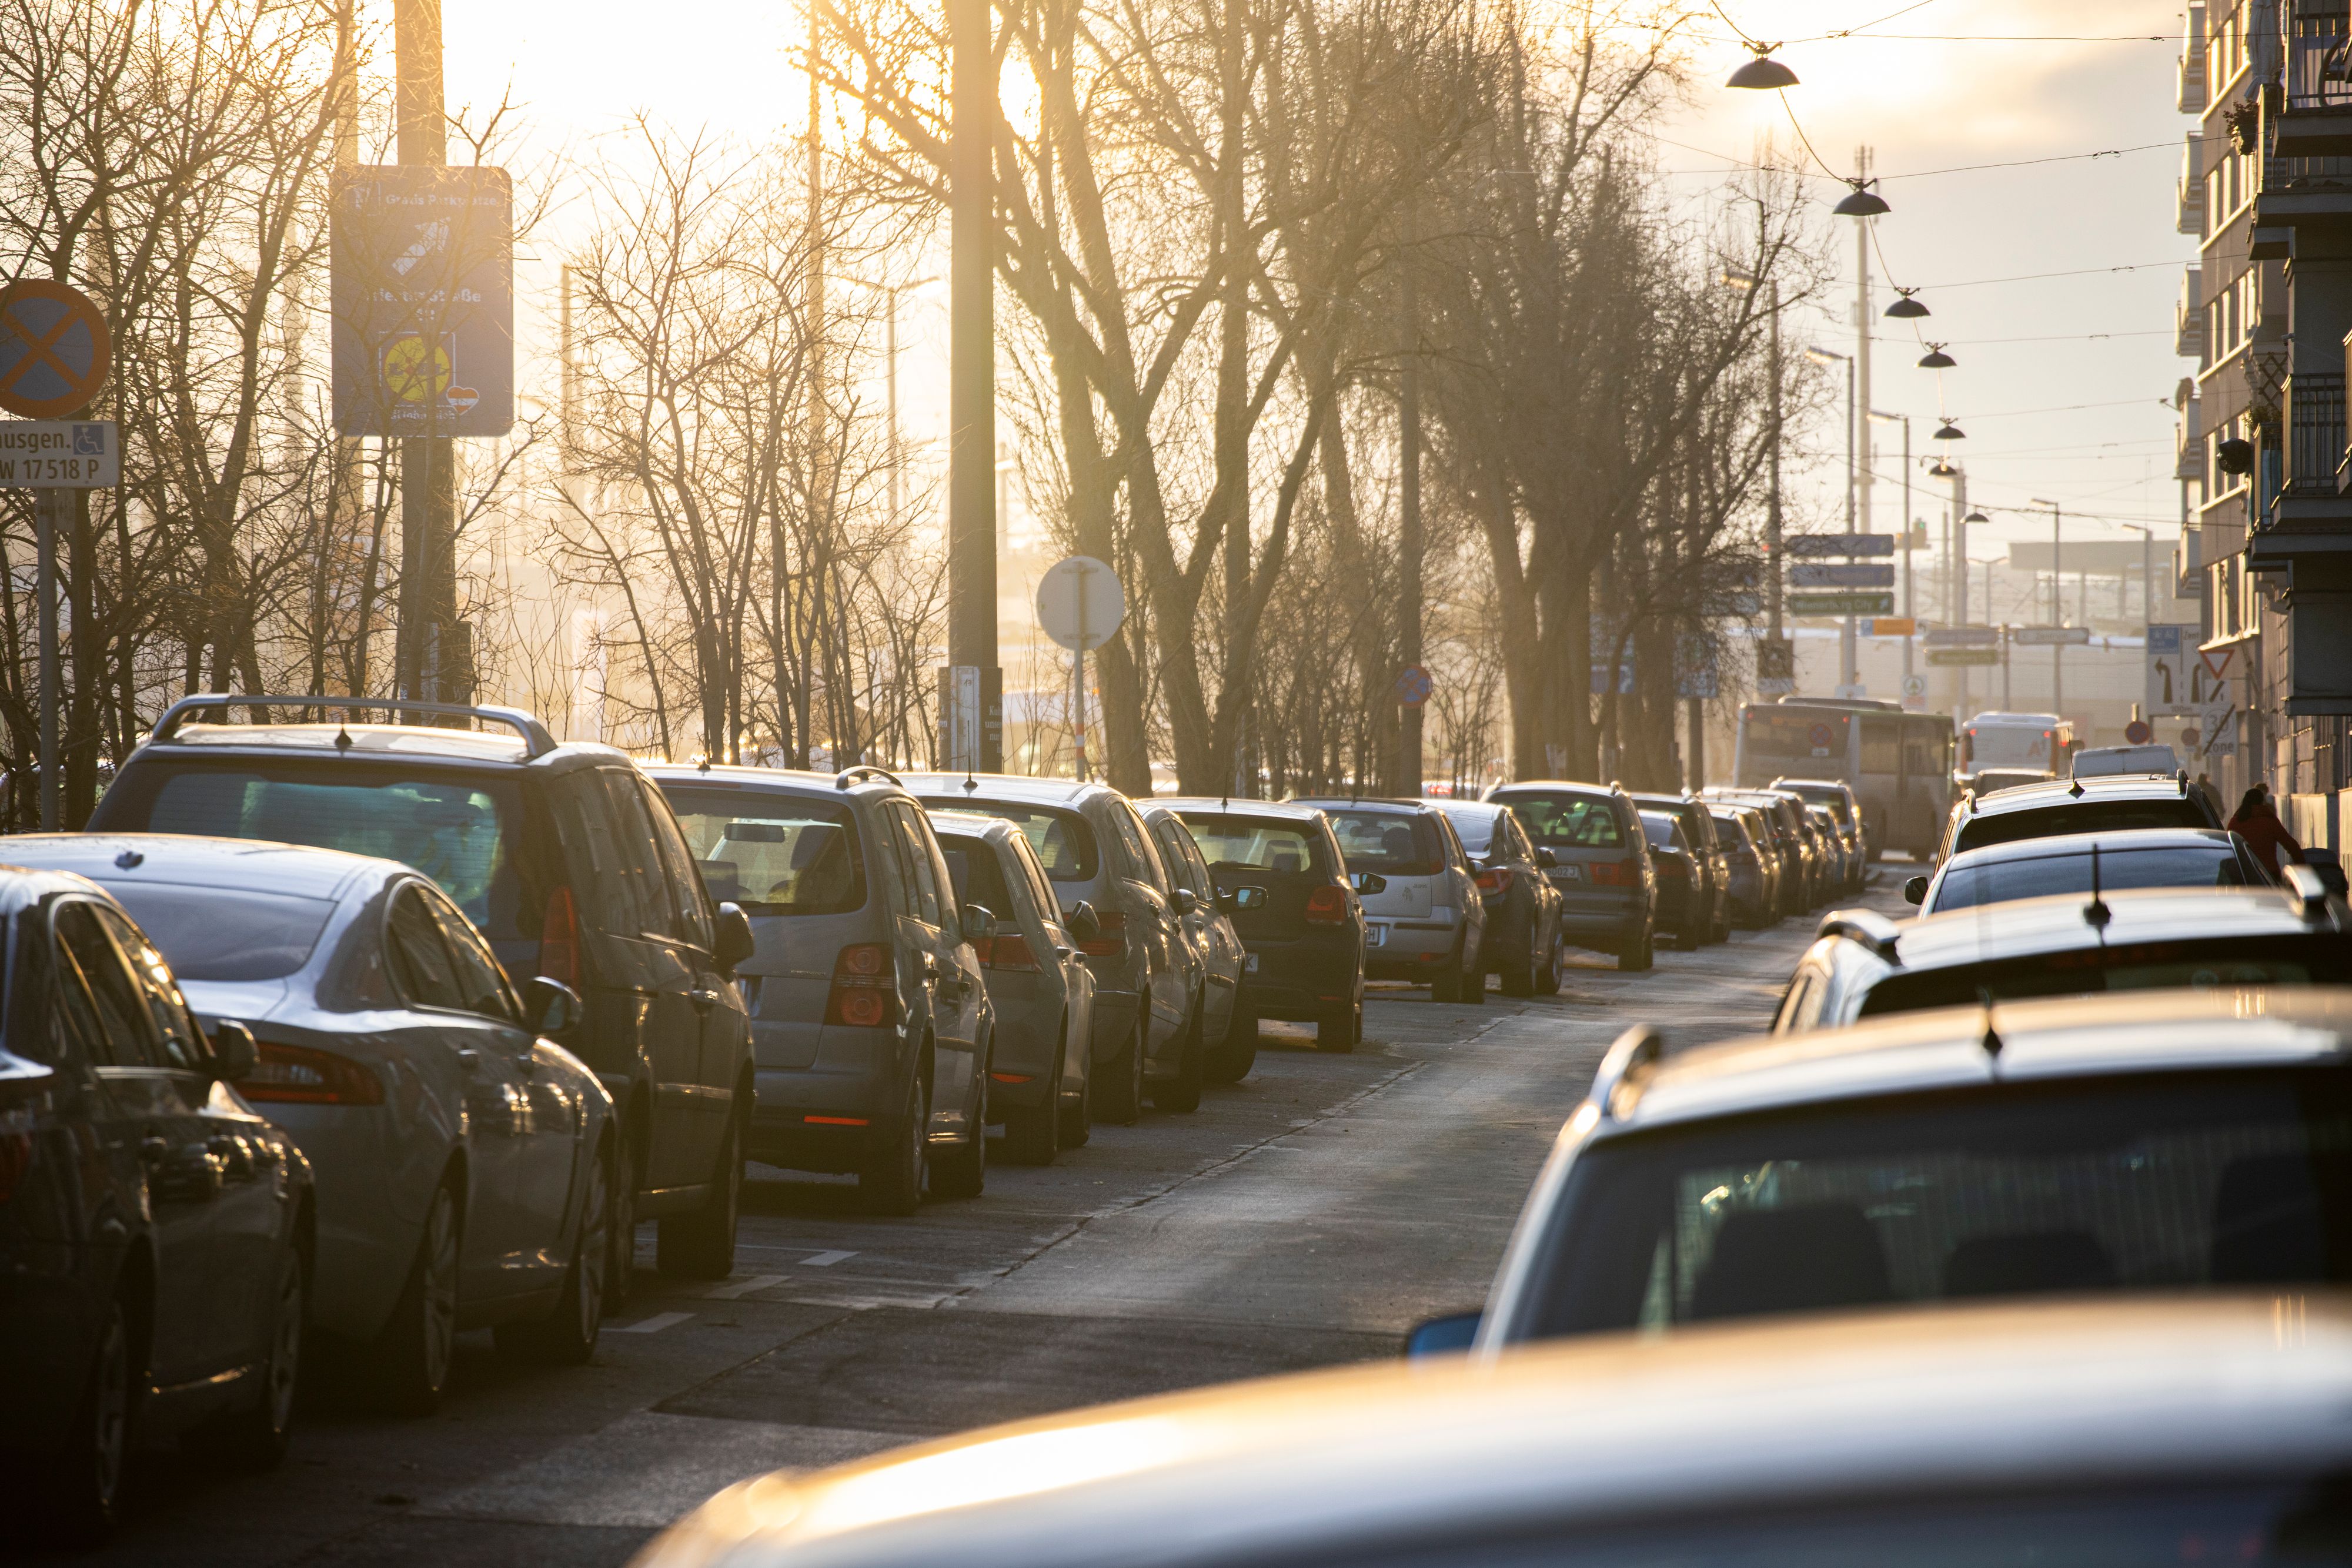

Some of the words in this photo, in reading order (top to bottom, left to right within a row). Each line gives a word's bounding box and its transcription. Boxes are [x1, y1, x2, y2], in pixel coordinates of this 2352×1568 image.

[428, 288, 480, 302] Staße
[0, 433, 71, 453] usgen.
[88, 459, 99, 479] P
